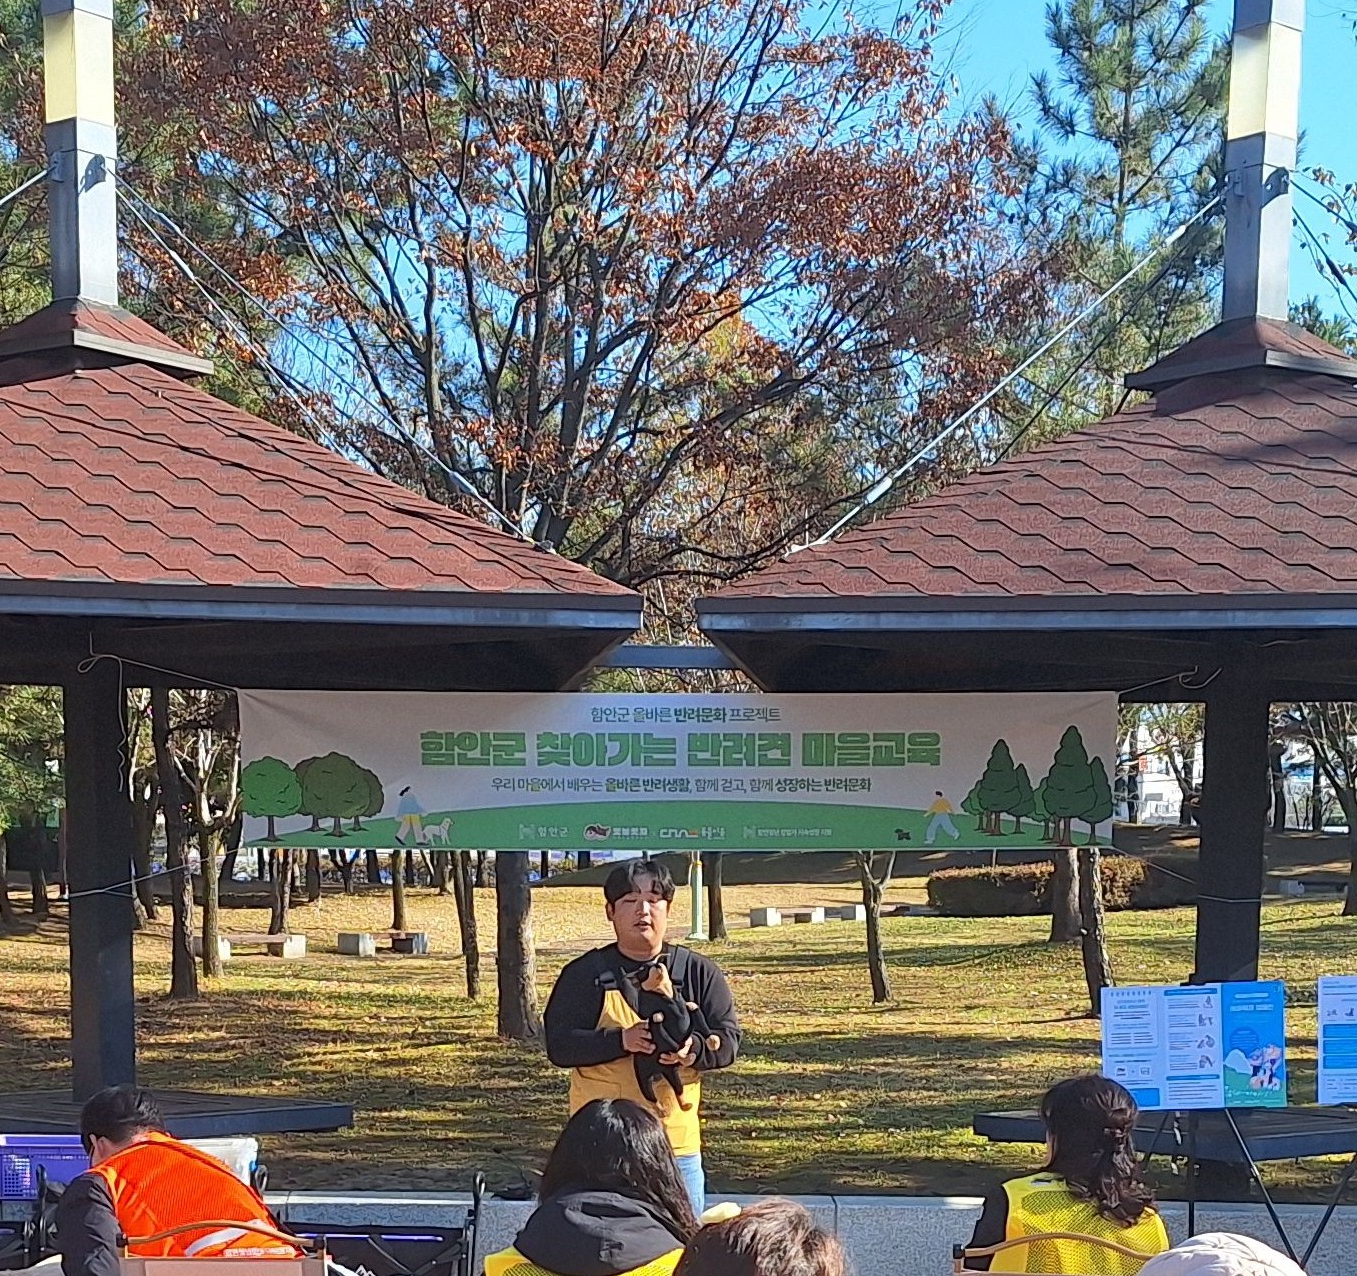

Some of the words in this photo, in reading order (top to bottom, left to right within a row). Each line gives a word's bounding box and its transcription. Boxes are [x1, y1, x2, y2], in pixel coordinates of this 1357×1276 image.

[591, 707, 630, 723] 함안군
[633, 707, 672, 723] 올바른
[674, 707, 727, 723] 반려문화
[729, 707, 782, 723] 프로젝트
[420, 731, 527, 767] 함안군
[536, 731, 677, 767] 찾아가는
[687, 732, 792, 767] 반려견
[801, 732, 941, 767] 마을교육
[491, 778, 515, 792] 우리
[518, 777, 564, 792] 마을에서
[567, 777, 603, 792] 배우는
[605, 777, 641, 793] 올바른
[643, 777, 692, 794] 반려생활,
[695, 777, 719, 792] 함께
[749, 777, 773, 792] 함께
[775, 777, 822, 793] 성장하는
[824, 777, 871, 793] 반려문화
[537, 826, 569, 838] 함안군
